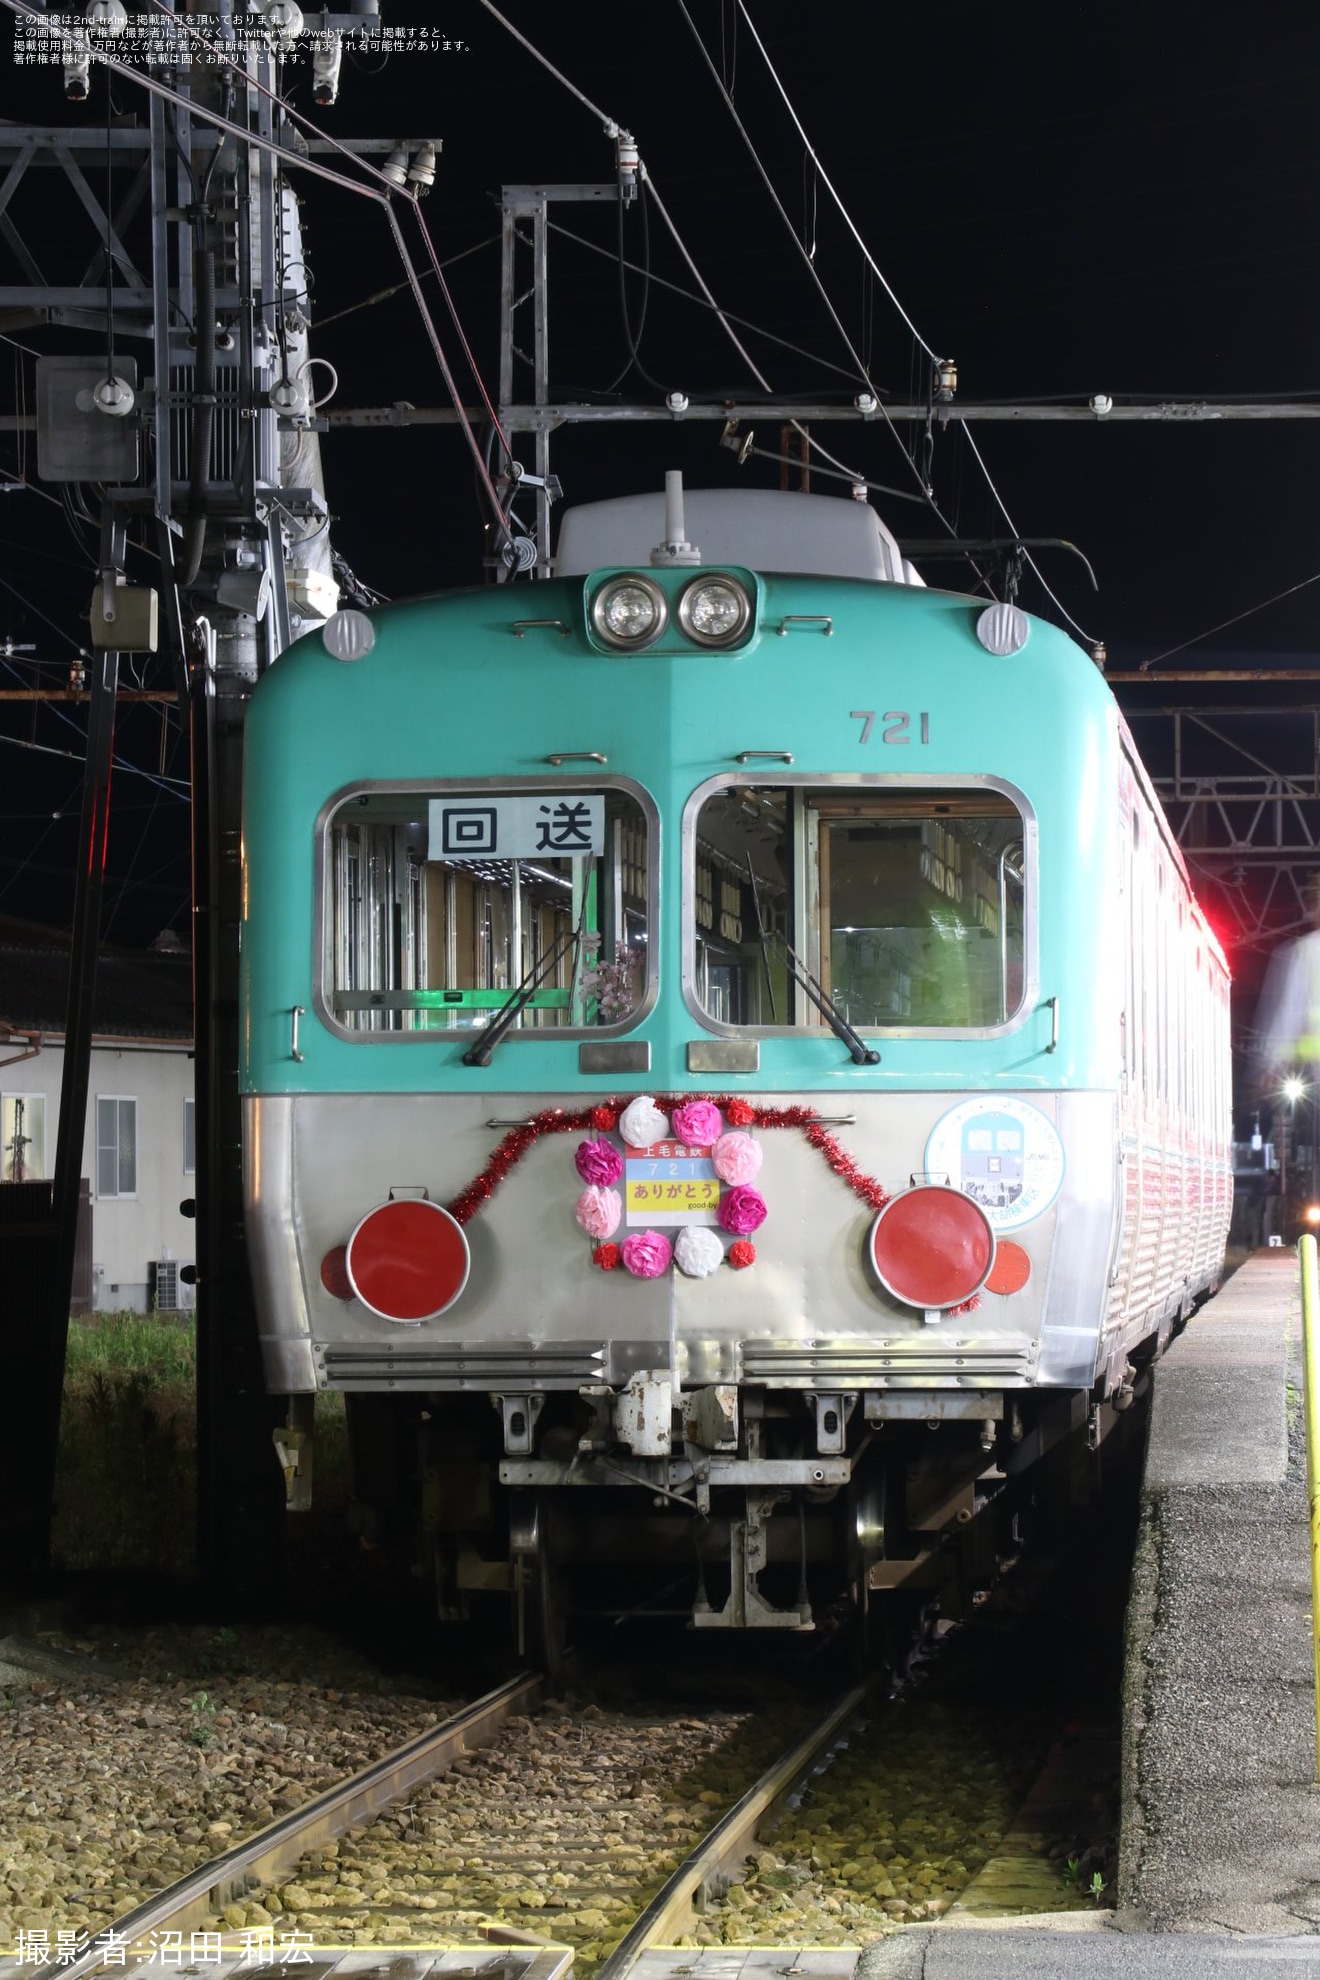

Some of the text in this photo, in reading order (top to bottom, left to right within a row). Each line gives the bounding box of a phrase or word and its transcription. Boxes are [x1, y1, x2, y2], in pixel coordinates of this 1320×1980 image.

[850, 711, 930, 744] 721
[442, 801, 594, 855] 回送
[634, 1183, 713, 1200] ありがとう
